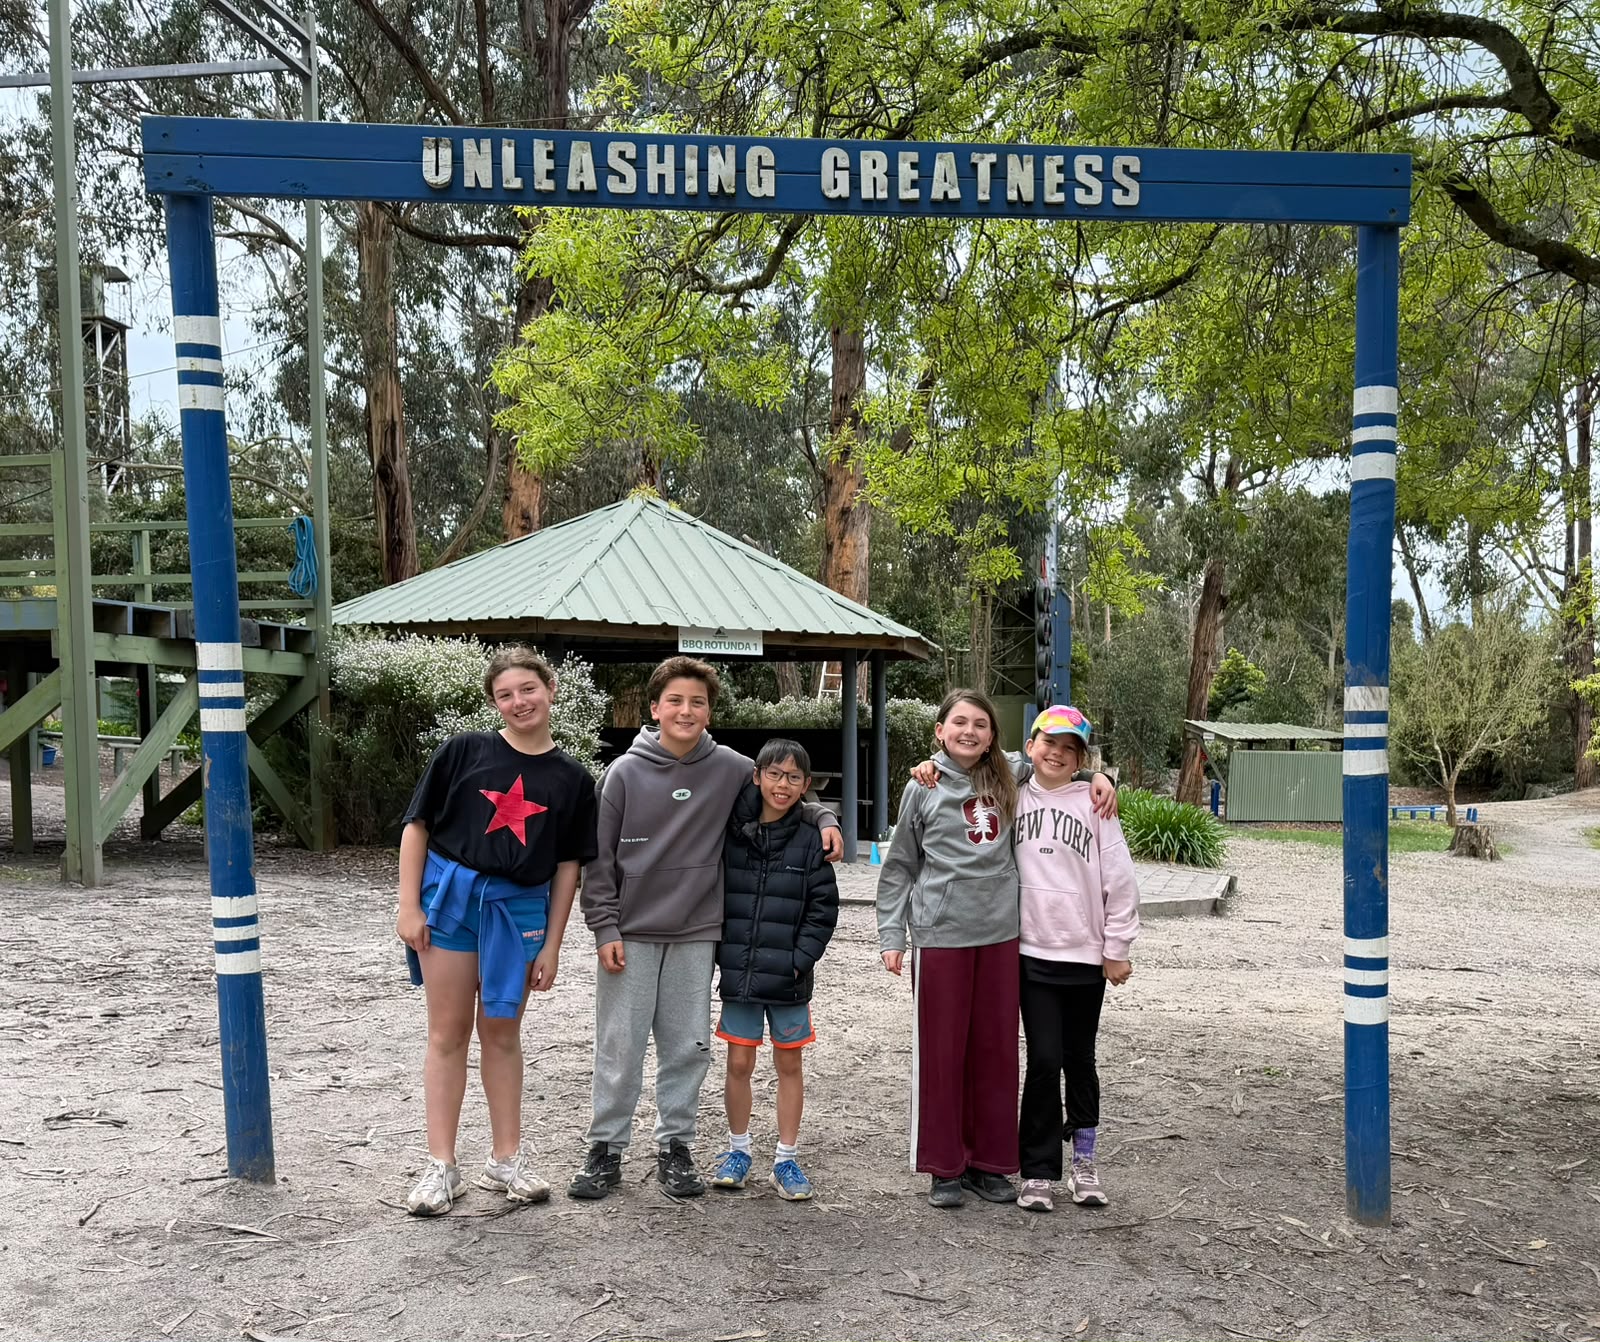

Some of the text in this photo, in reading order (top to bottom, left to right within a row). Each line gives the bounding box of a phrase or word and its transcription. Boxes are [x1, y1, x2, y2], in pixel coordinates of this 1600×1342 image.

[421, 136, 1142, 206] UNLEASHING GREATNESS
[682, 639, 758, 651] BBQ ROTUNDA 1
[1050, 807, 1094, 864] YORK
